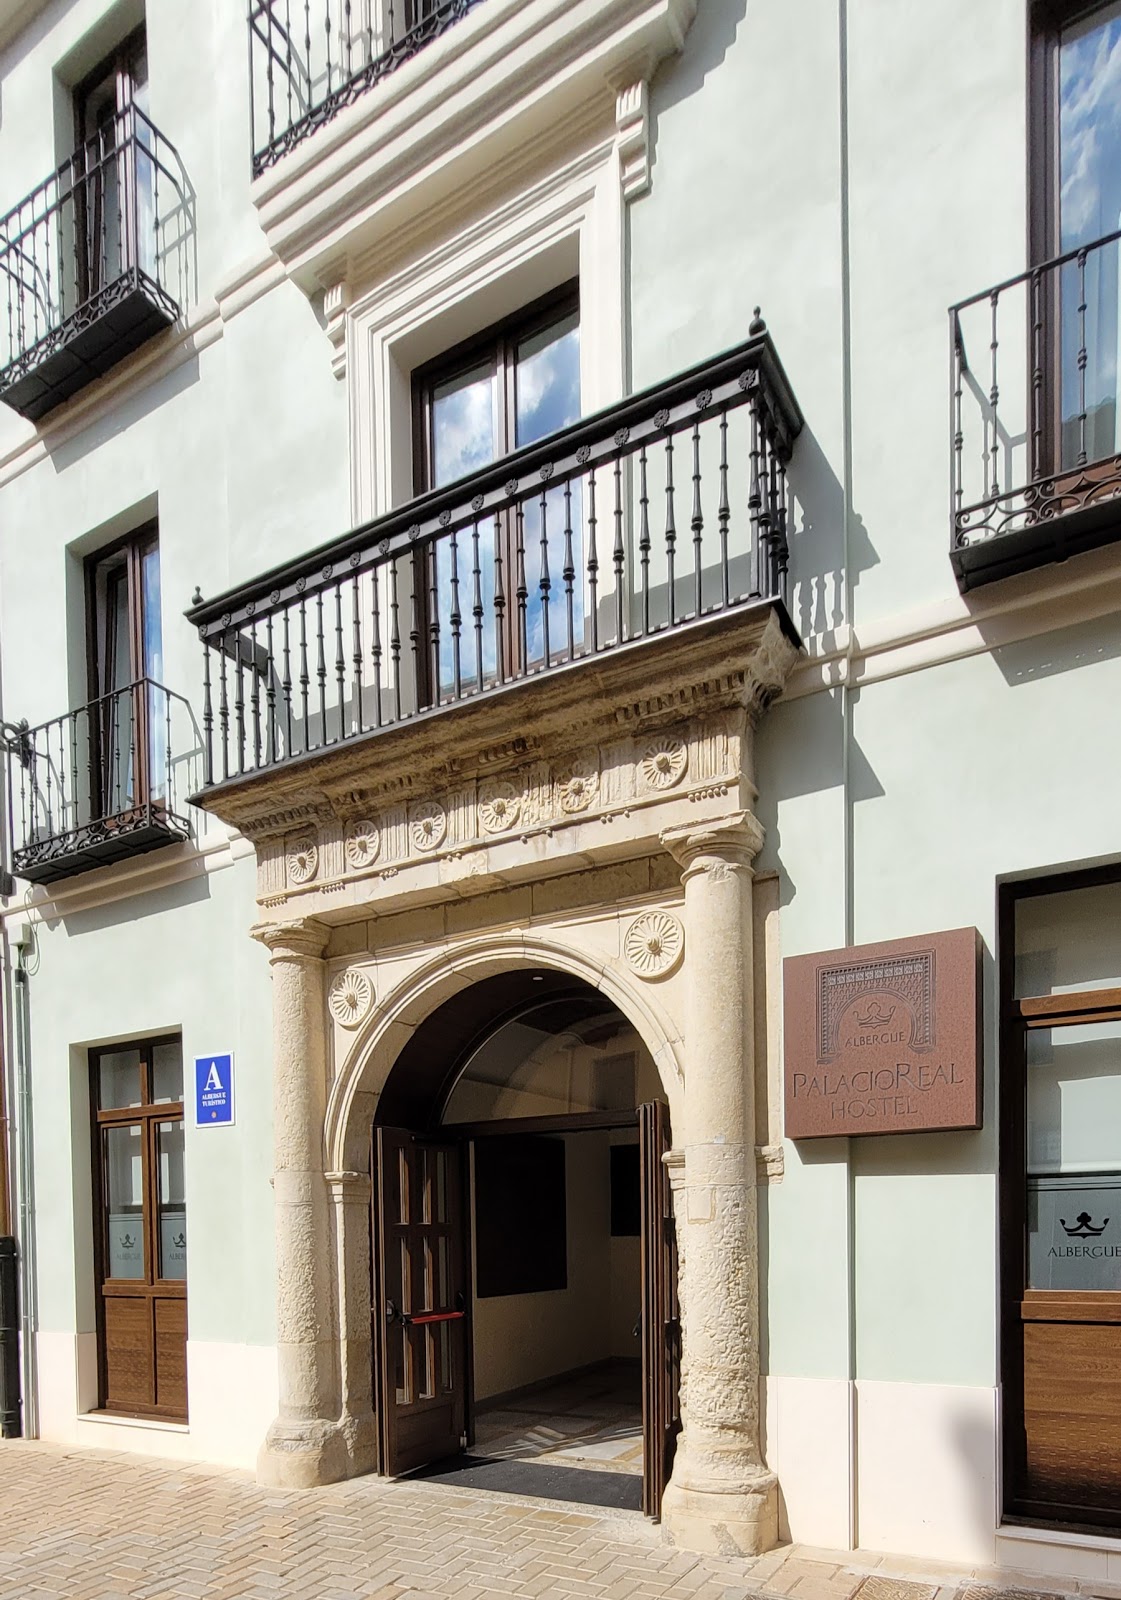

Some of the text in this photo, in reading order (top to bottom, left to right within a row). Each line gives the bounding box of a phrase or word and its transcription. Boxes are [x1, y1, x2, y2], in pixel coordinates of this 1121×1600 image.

[845, 1031, 906, 1048] ALBERGUE
[203, 1061, 223, 1091] A
[831, 1095, 918, 1120] HOSTEL
[1047, 1246, 1121, 1259] ALBERGUE
